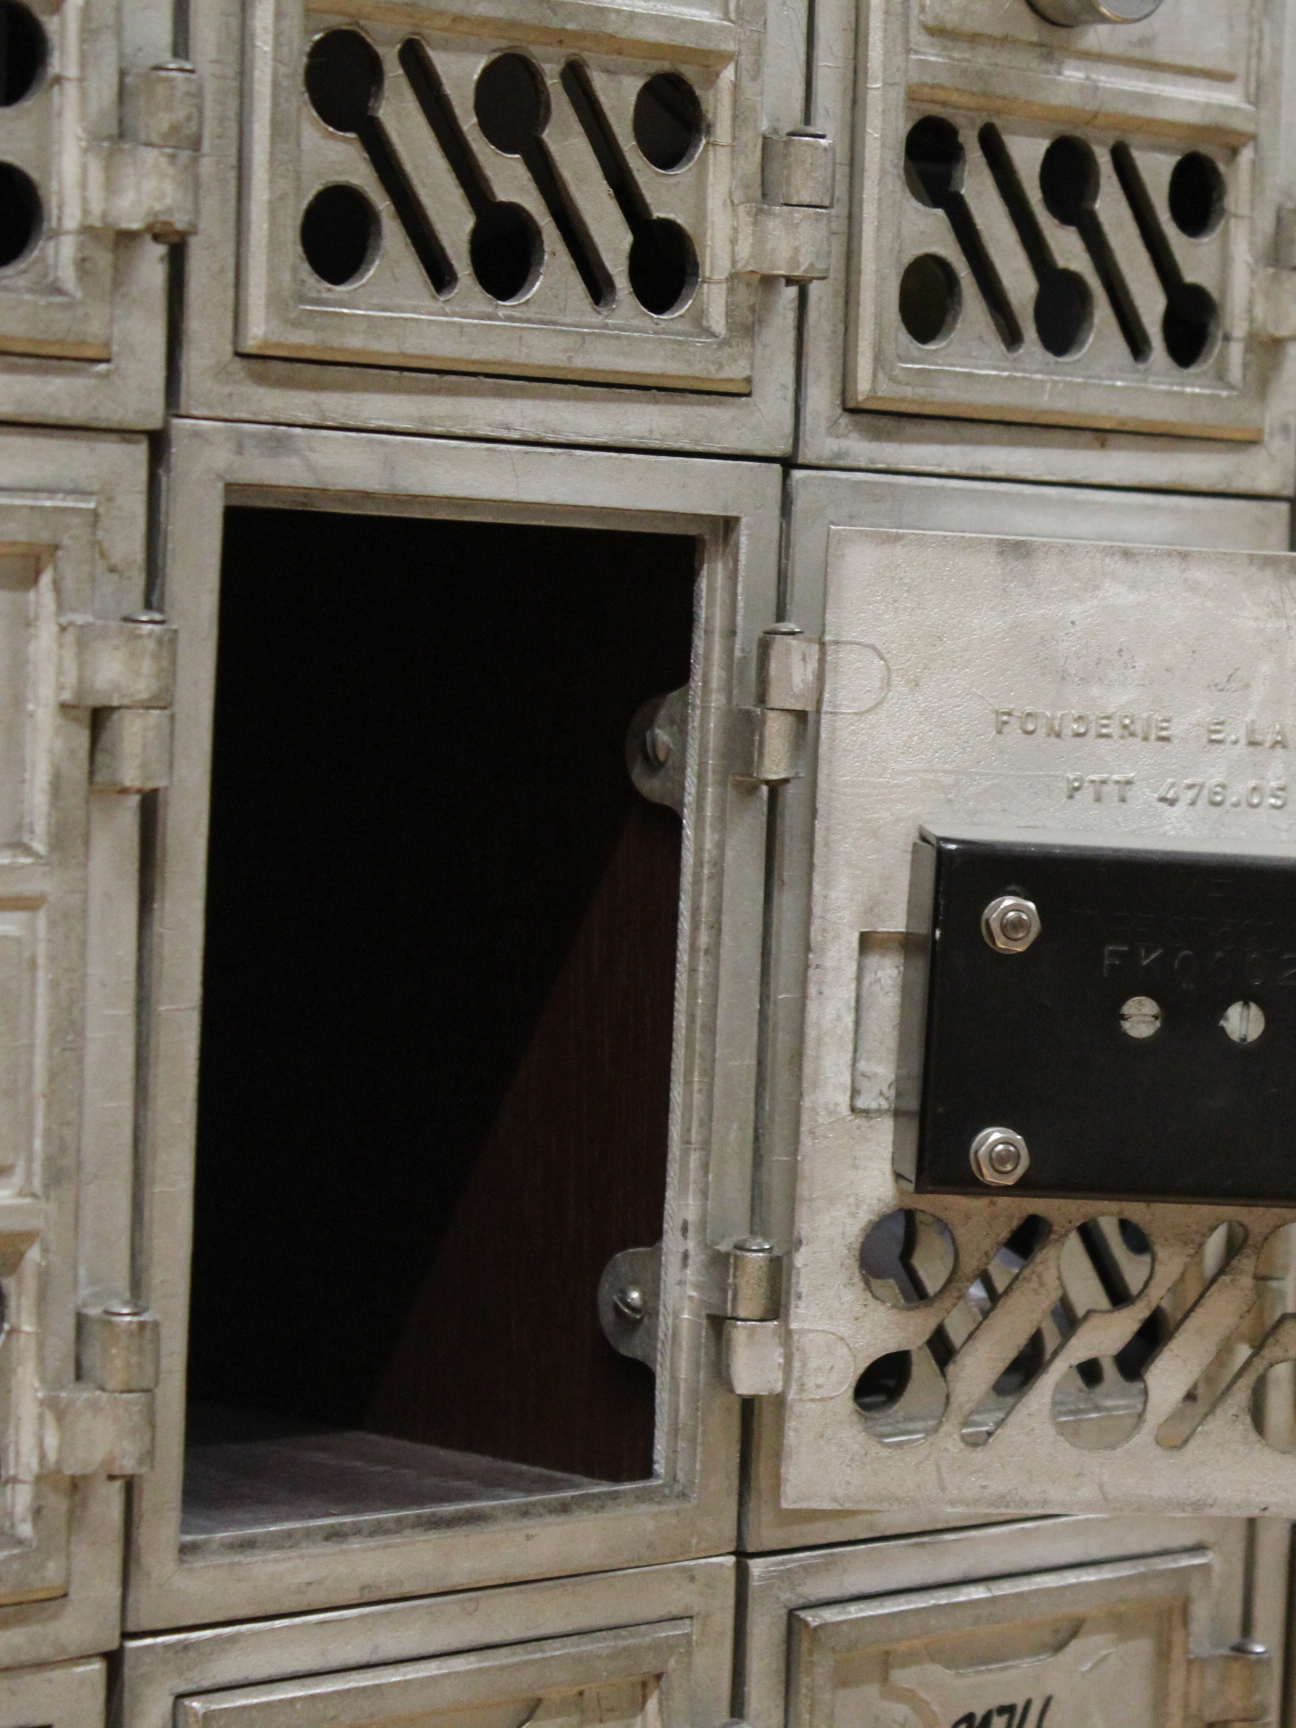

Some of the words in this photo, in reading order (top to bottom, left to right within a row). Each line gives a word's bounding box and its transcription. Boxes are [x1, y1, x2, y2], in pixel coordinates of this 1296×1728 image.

[994, 708, 1175, 743] FONDERIE
[1065, 772, 1136, 804] PTT
[1156, 780, 1289, 810] 476.05
